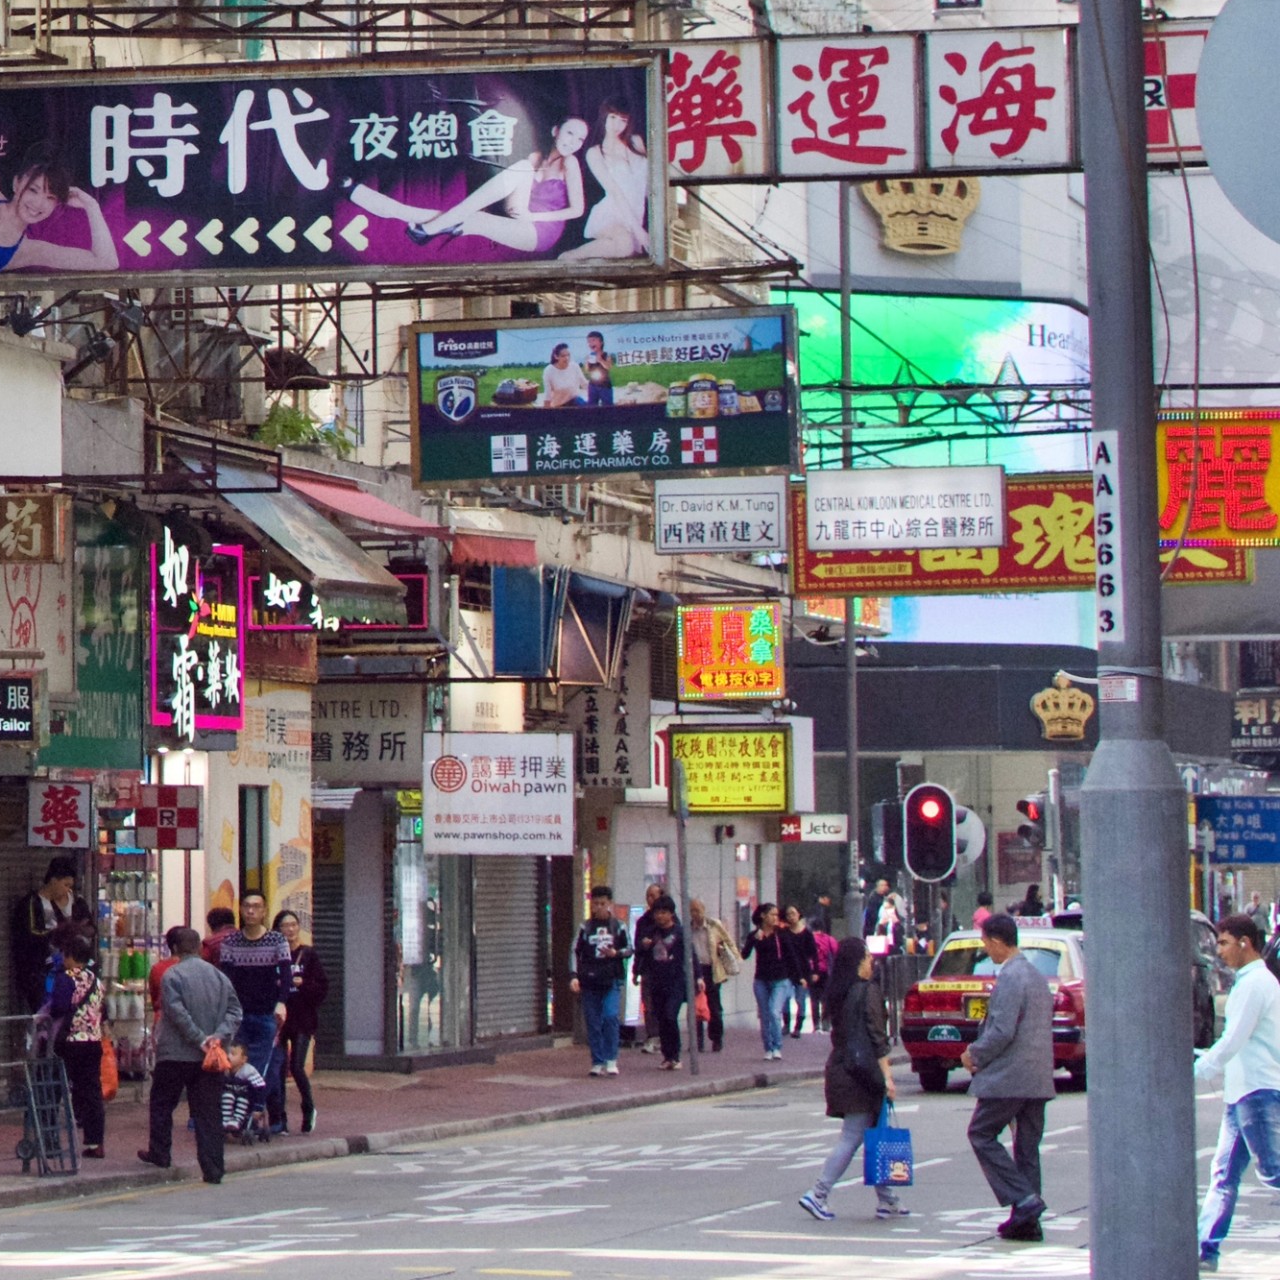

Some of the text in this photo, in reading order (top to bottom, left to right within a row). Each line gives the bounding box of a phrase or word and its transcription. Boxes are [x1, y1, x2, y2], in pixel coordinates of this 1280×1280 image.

[90, 88, 519, 198] 時代 夜總會
[438, 337, 466, 350] Friso
[536, 427, 671, 458] 海運藥房
[536, 454, 671, 470] PACIFIC PHARMACY CO.
[1160, 426, 1278, 530] 麗
[662, 501, 679, 512] Dr.
[681, 500, 713, 512] David
[746, 499, 774, 514] Tung
[815, 494, 995, 512] CENTRAL KOWLOON MEDICAL CENTRE LTD.
[664, 521, 774, 543] 西醫董建文
[815, 516, 994, 541] 九龍市中心綜合醫務所
[749, 609, 774, 664] 桑拿
[370, 701, 408, 718] LTD.
[471, 779, 567, 796] Oiwah pawn
[34, 787, 85, 846] 藥
[434, 831, 563, 842] www.pawnshop.com.hk
[1243, 831, 1276, 842] Chung
